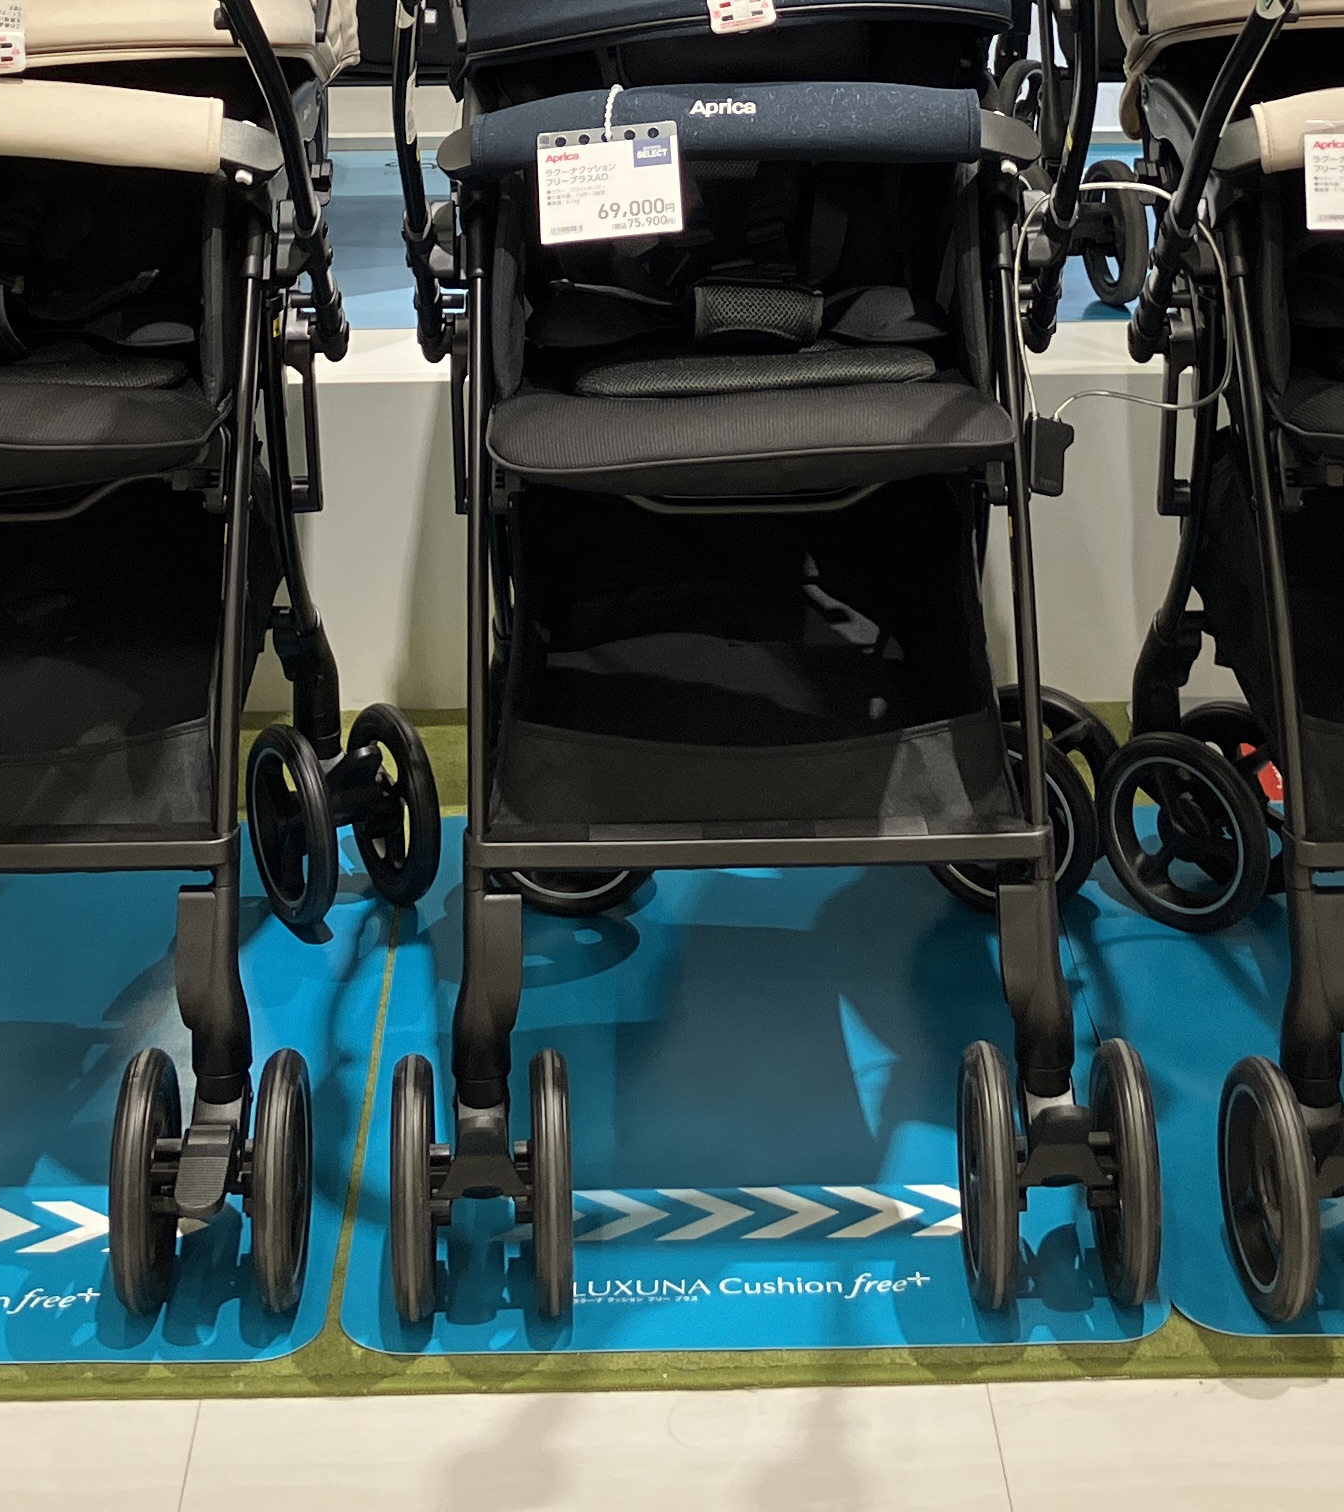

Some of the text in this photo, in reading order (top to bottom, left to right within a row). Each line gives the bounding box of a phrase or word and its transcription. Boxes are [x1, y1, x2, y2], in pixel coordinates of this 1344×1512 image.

[689, 98, 756, 117] Aprica
[545, 151, 579, 163] Aprica
[637, 148, 668, 159] SELECT
[545, 163, 616, 177] ラクーナクッション
[545, 172, 609, 186] フリープラスAD
[597, 198, 675, 220] 69,000円
[573, 1279, 711, 1297] LUXUNA
[719, 1277, 843, 1295] Cushion
